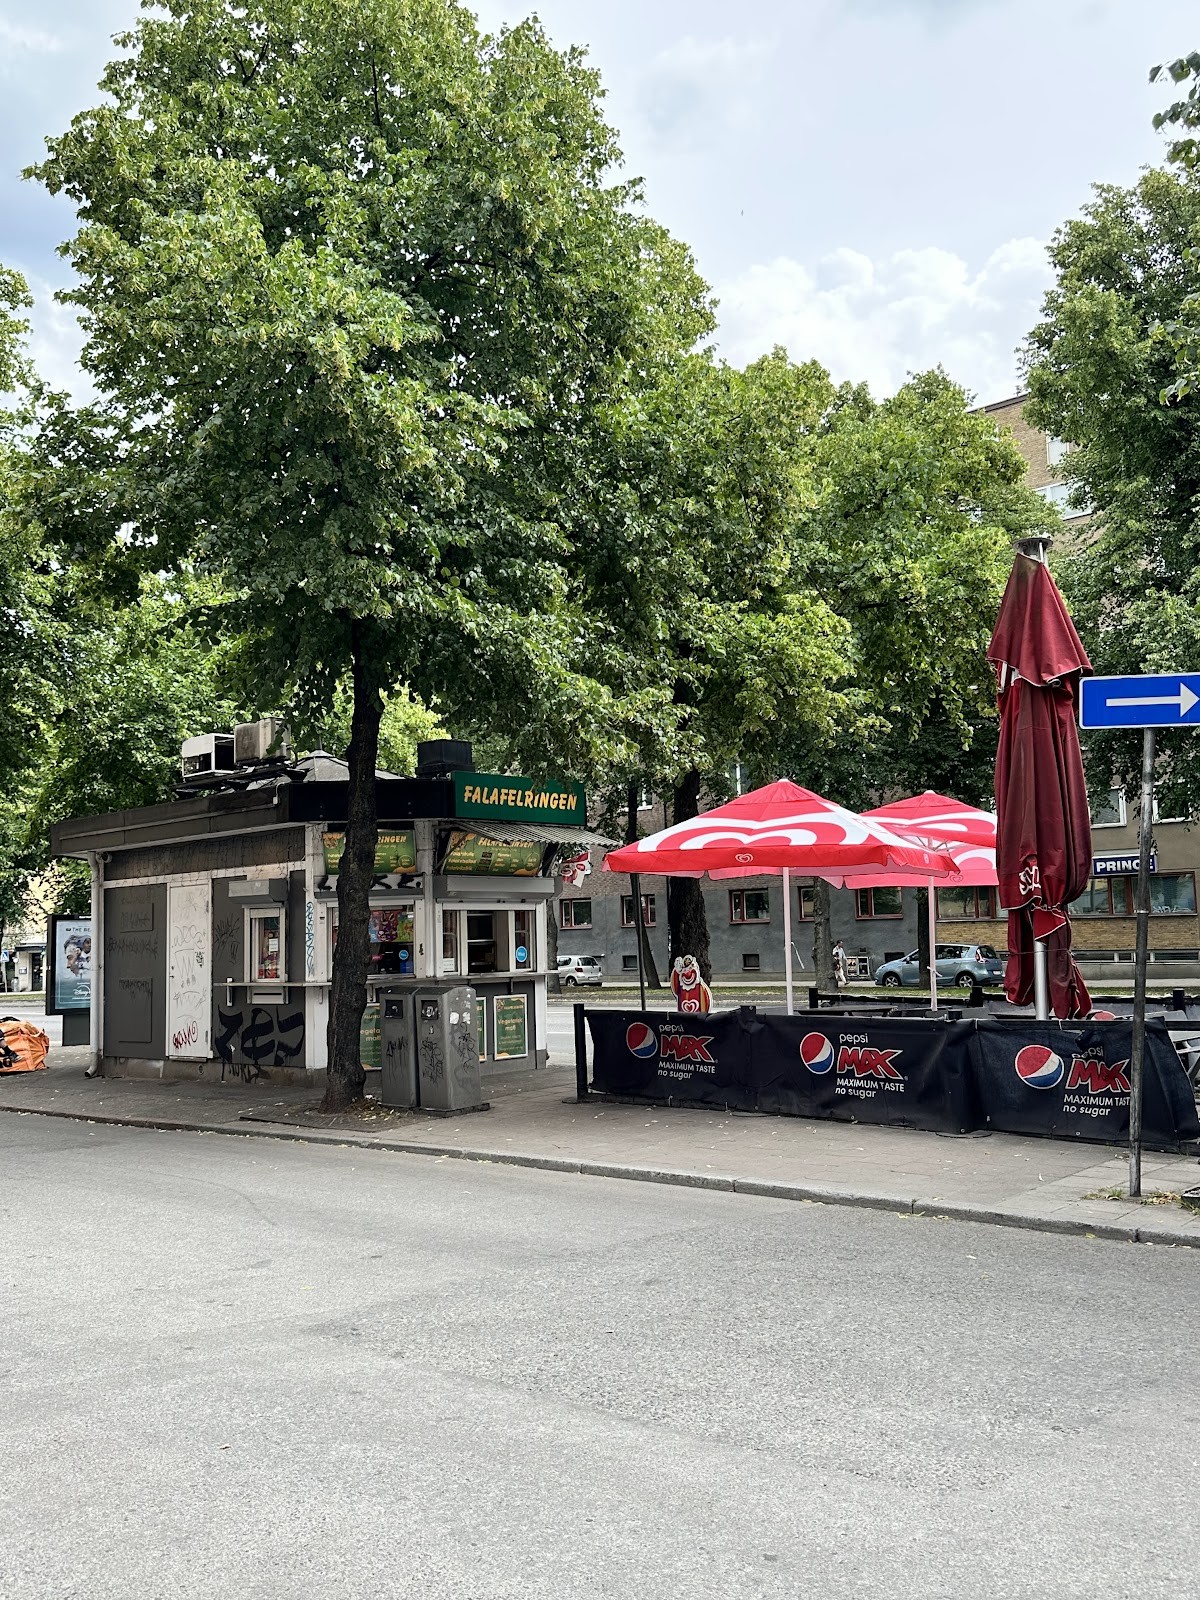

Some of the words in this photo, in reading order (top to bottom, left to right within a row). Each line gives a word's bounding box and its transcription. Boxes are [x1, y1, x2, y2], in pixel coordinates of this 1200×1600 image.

[464, 785, 577, 810] FALAFELRINGEN
[659, 1024, 684, 1033] pepsi
[839, 1033, 869, 1045] pepsi
[660, 1034, 715, 1063] MAX
[658, 1061, 695, 1072] MAXIMUM
[695, 1064, 716, 1074] TASTE
[836, 1046, 904, 1080] MAX
[657, 1069, 668, 1077] no
[669, 1071, 693, 1080] sugar
[836, 1078, 879, 1089] MAXIMUM
[879, 1081, 905, 1093] TASTE
[848, 1089, 877, 1099] sugar
[1063, 1094, 1114, 1107] MAXIMUM
[1114, 1097, 1131, 1107] TAST
[1062, 1105, 1077, 1113] no
[1079, 1106, 1111, 1118] sugar
